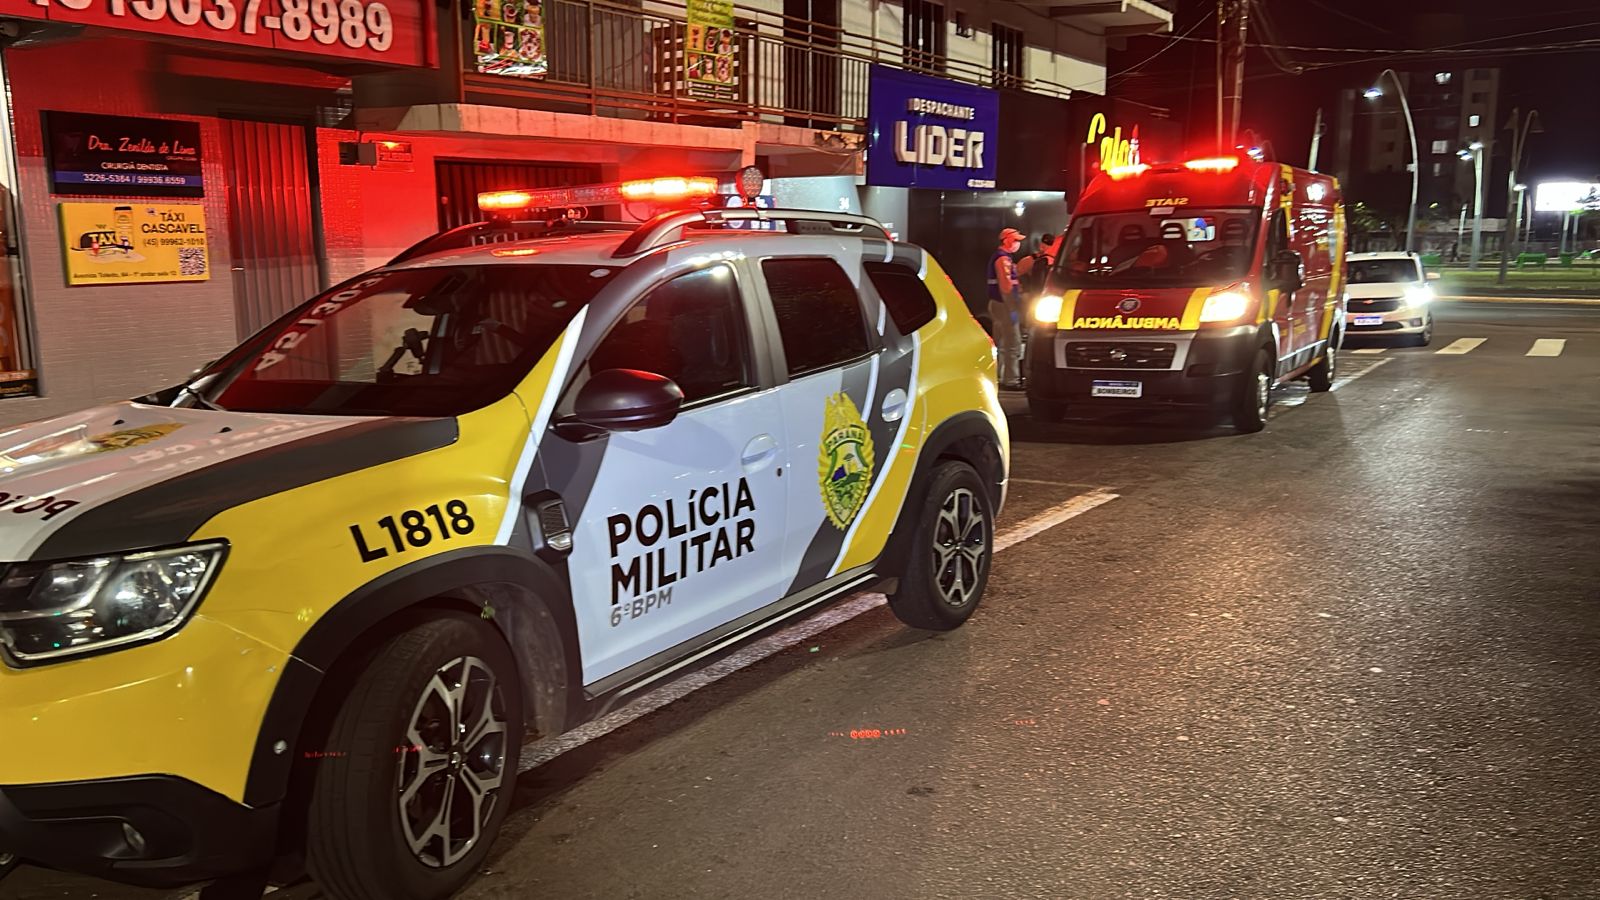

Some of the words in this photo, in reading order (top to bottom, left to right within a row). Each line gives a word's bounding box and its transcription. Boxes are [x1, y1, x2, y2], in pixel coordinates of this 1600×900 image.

[911, 98, 975, 120] DESPACHANTE
[896, 121, 984, 168] LIDER
[141, 223, 205, 233] CASCAVEL
[160, 209, 185, 222] TÁXI
[349, 499, 475, 563] L1818
[607, 477, 756, 558] POLÍCIA
[610, 518, 756, 606] MILITAR
